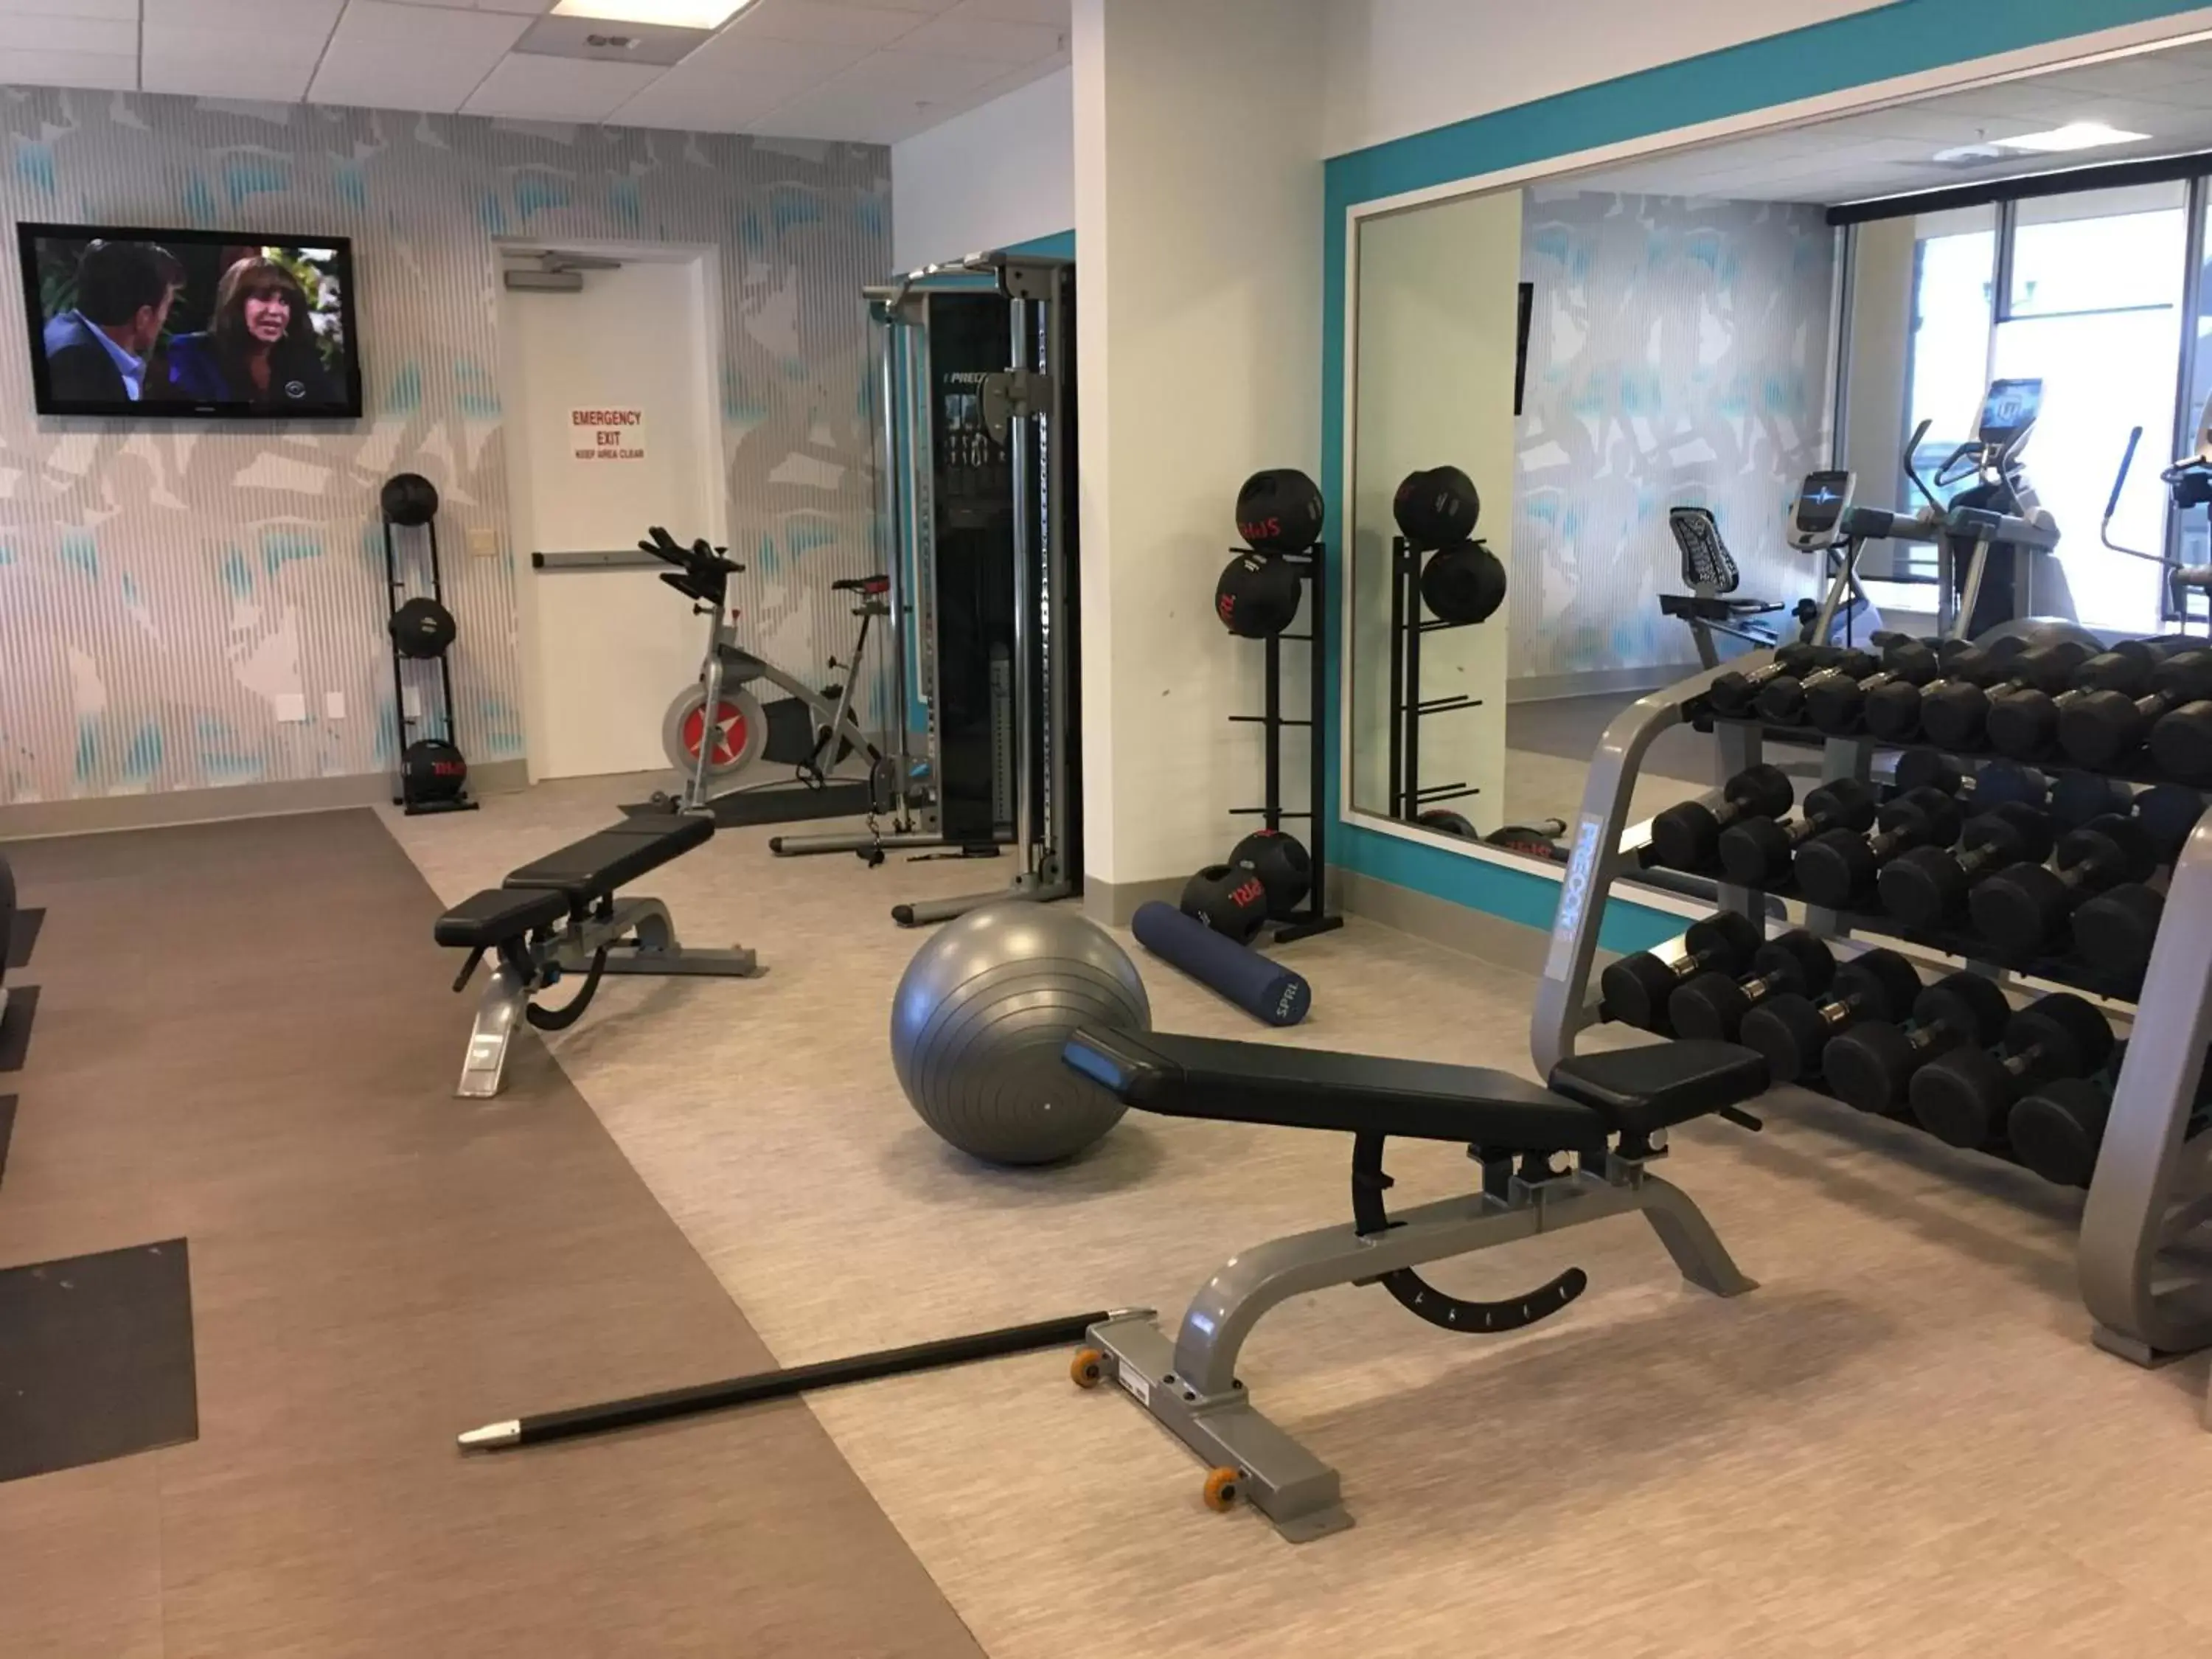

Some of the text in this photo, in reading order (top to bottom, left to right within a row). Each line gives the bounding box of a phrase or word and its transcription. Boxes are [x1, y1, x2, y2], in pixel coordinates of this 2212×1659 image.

[573, 410, 641, 425] EMERGENCY
[597, 431, 621, 445] EXIT
[1562, 822, 1599, 928] PRECOR
[1276, 982, 1298, 1018] SPRI
